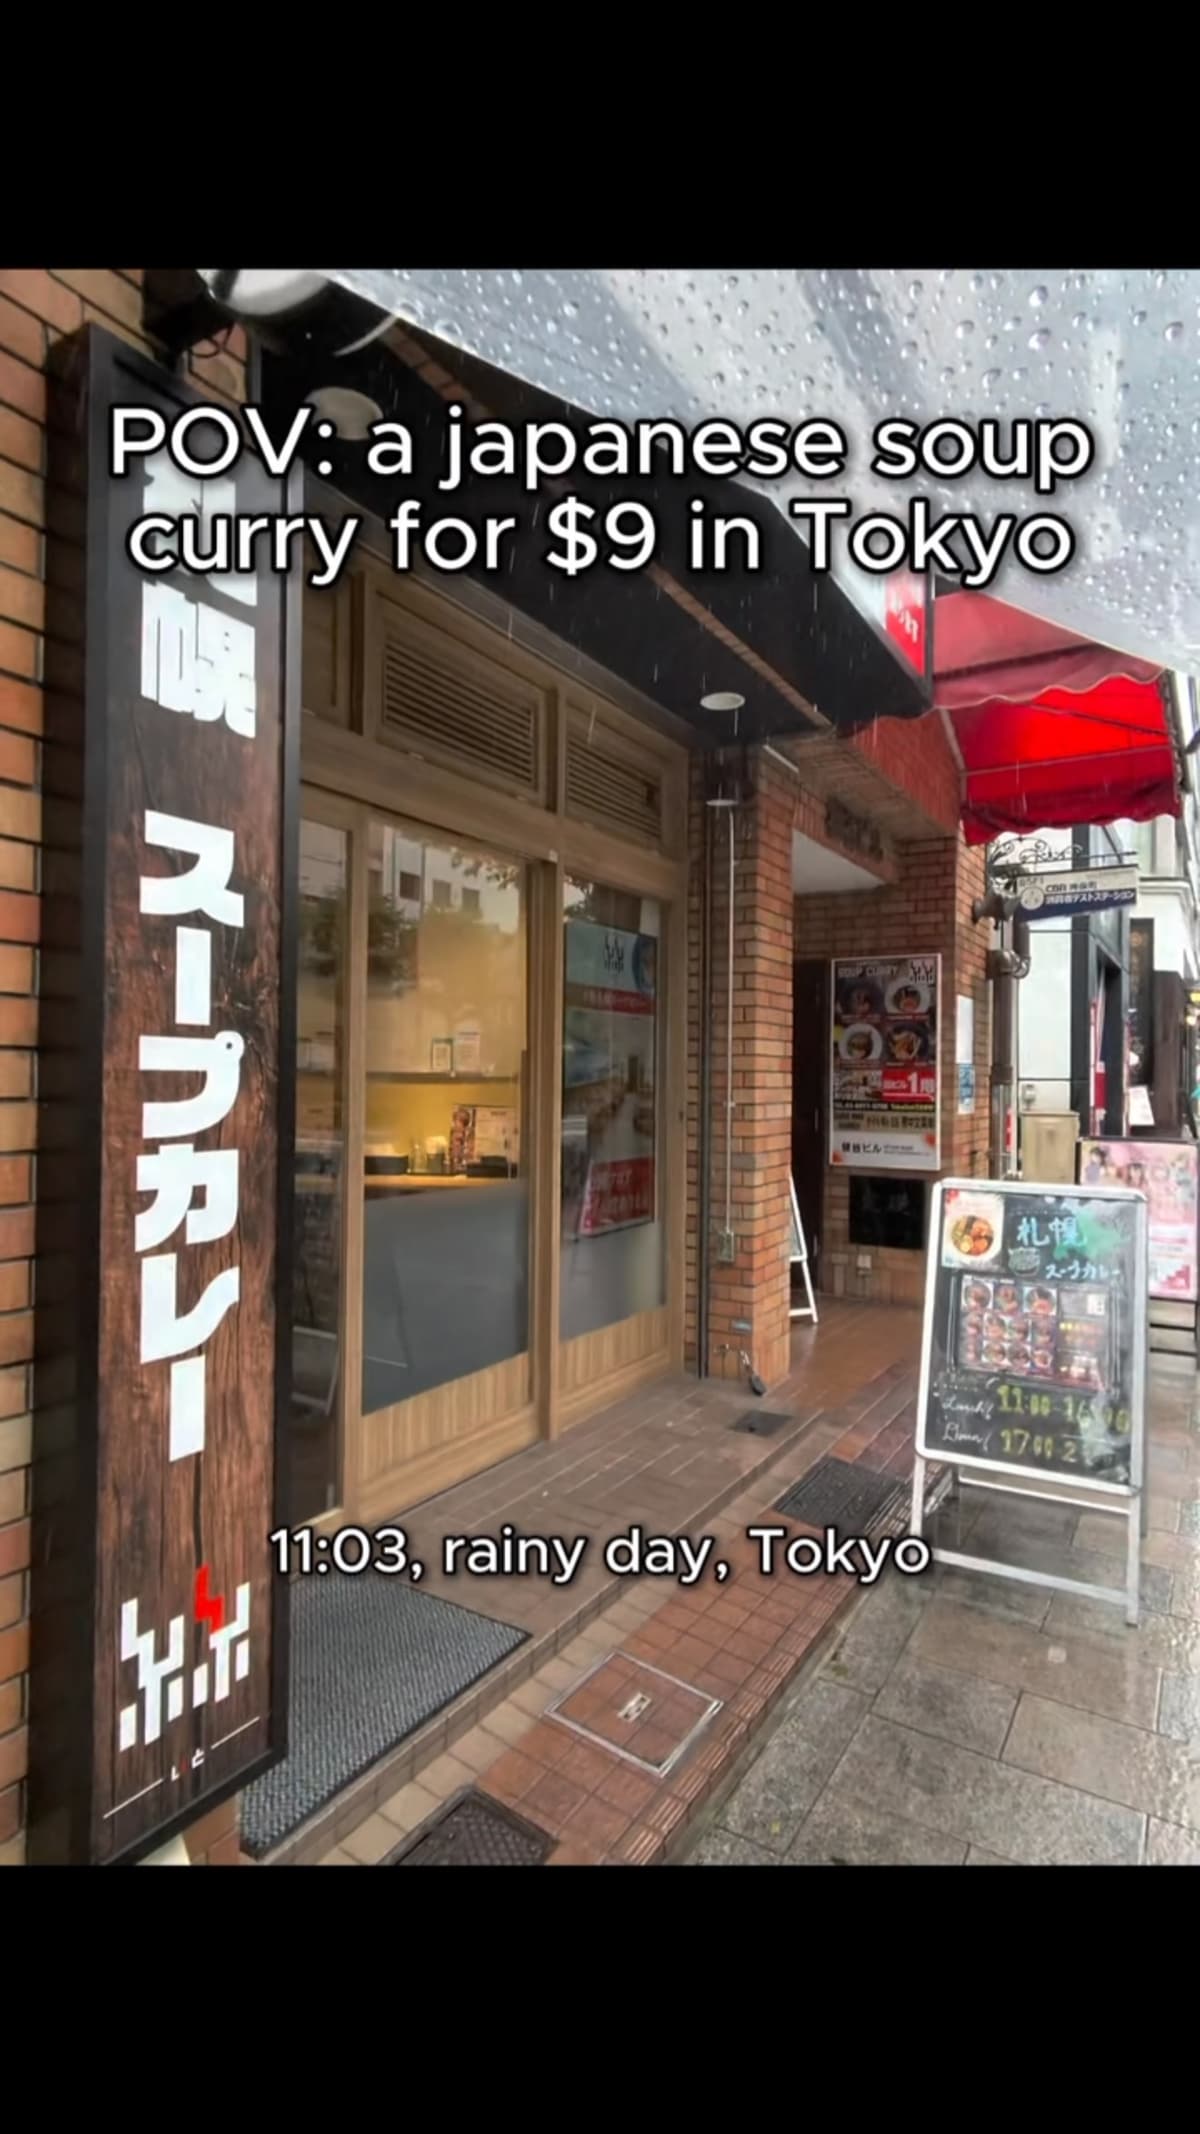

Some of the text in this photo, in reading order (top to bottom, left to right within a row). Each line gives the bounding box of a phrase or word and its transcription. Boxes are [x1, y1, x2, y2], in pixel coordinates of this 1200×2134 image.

[134, 809, 246, 1463] スープカレー
